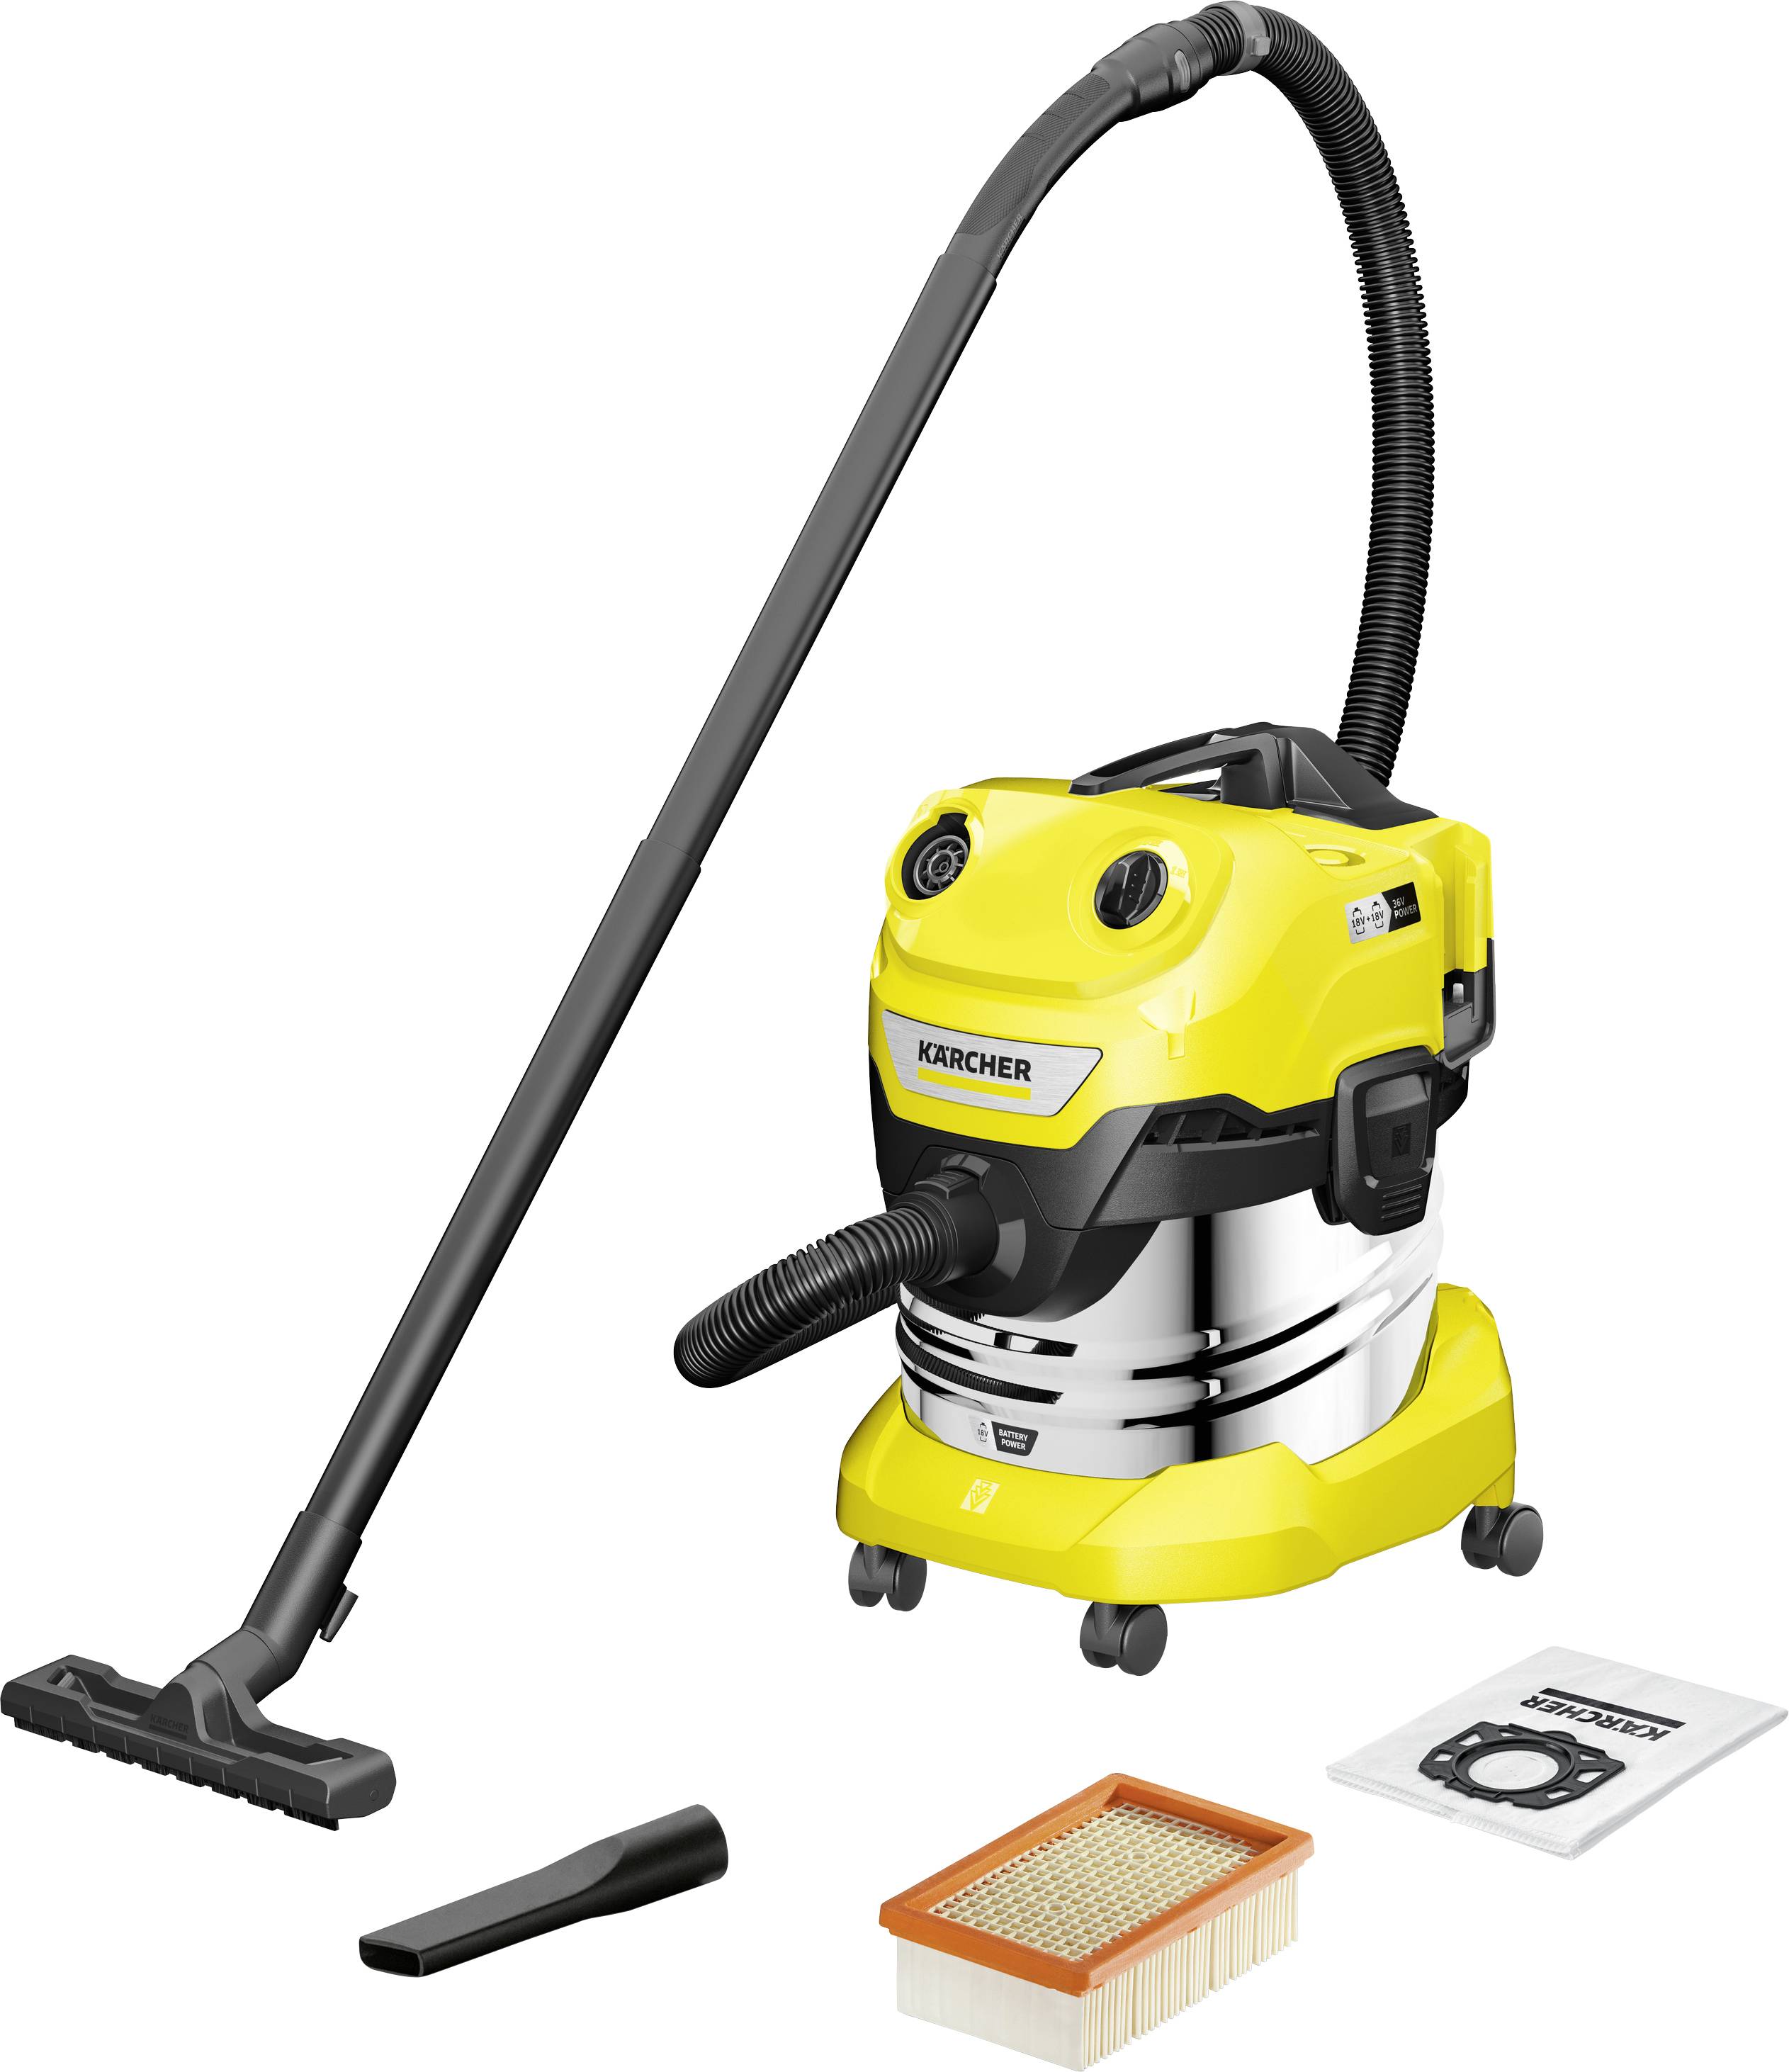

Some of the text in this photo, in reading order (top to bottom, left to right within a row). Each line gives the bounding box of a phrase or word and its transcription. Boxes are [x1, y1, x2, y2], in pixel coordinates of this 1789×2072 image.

[1392, 896, 1405, 908] 36V
[1394, 904, 1418, 919] POWER
[918, 1040, 1032, 1082] KÄRCHER
[978, 1429, 988, 1437] 18V
[998, 1429, 1028, 1442] BATTERY
[1001, 1438, 1026, 1451] POWER
[1520, 1695, 1671, 1741] KÄRCHER
